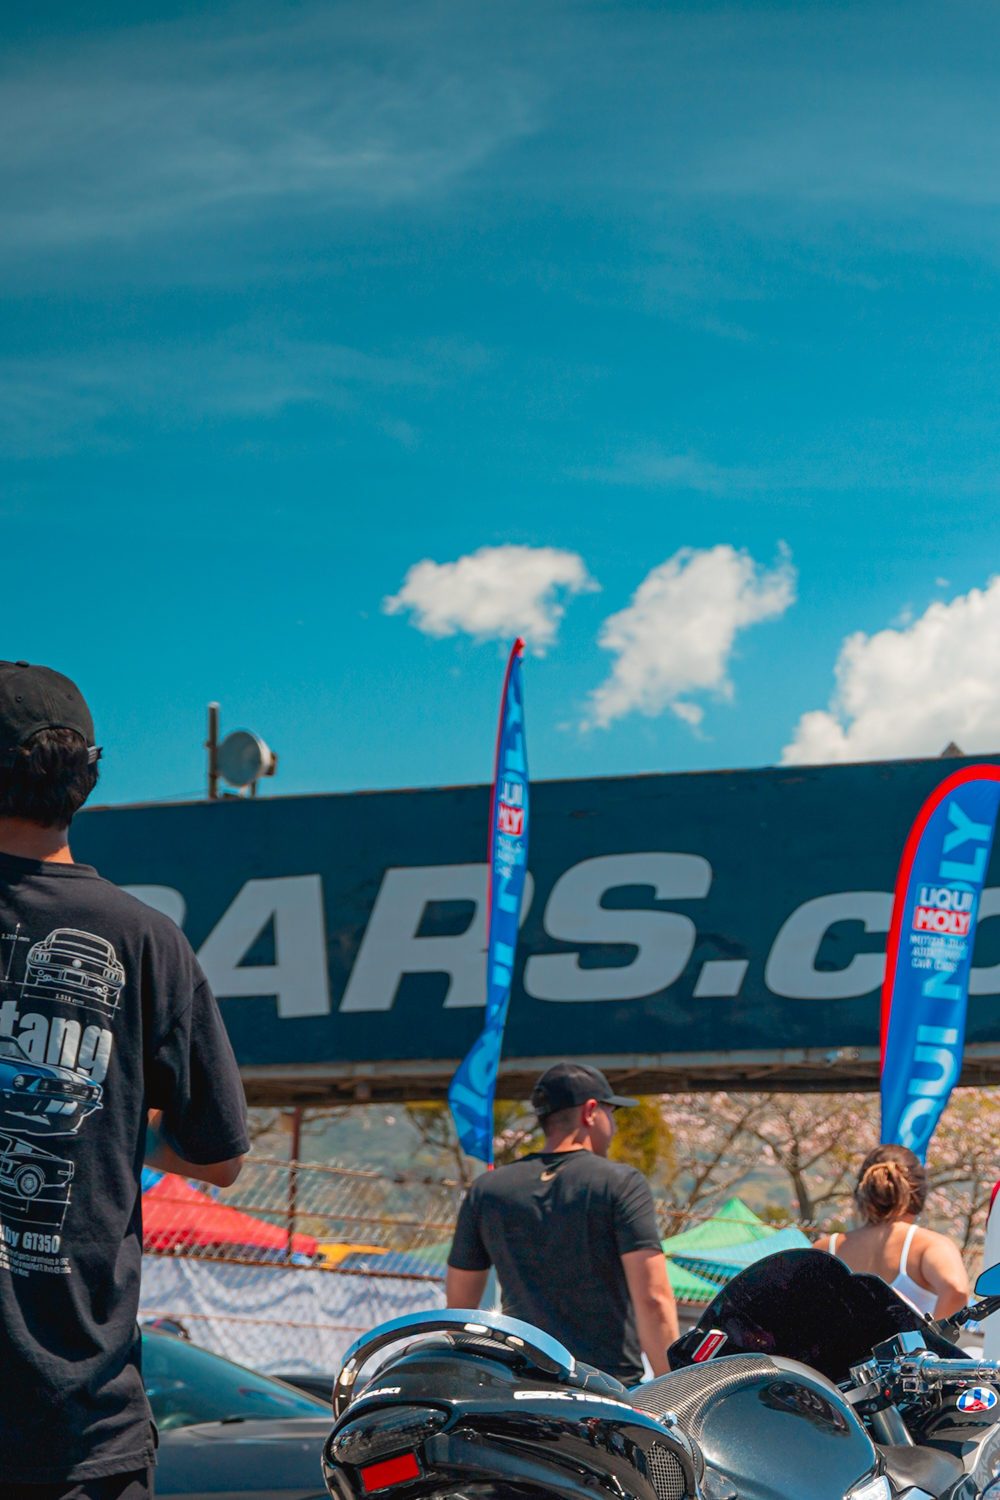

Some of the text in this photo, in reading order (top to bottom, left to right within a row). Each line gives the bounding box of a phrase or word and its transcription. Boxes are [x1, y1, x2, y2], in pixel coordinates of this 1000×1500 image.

[920, 887, 974, 911] LIQUI
[916, 909, 971, 933] MOLY
[22, 1231, 61, 1254] GT350
